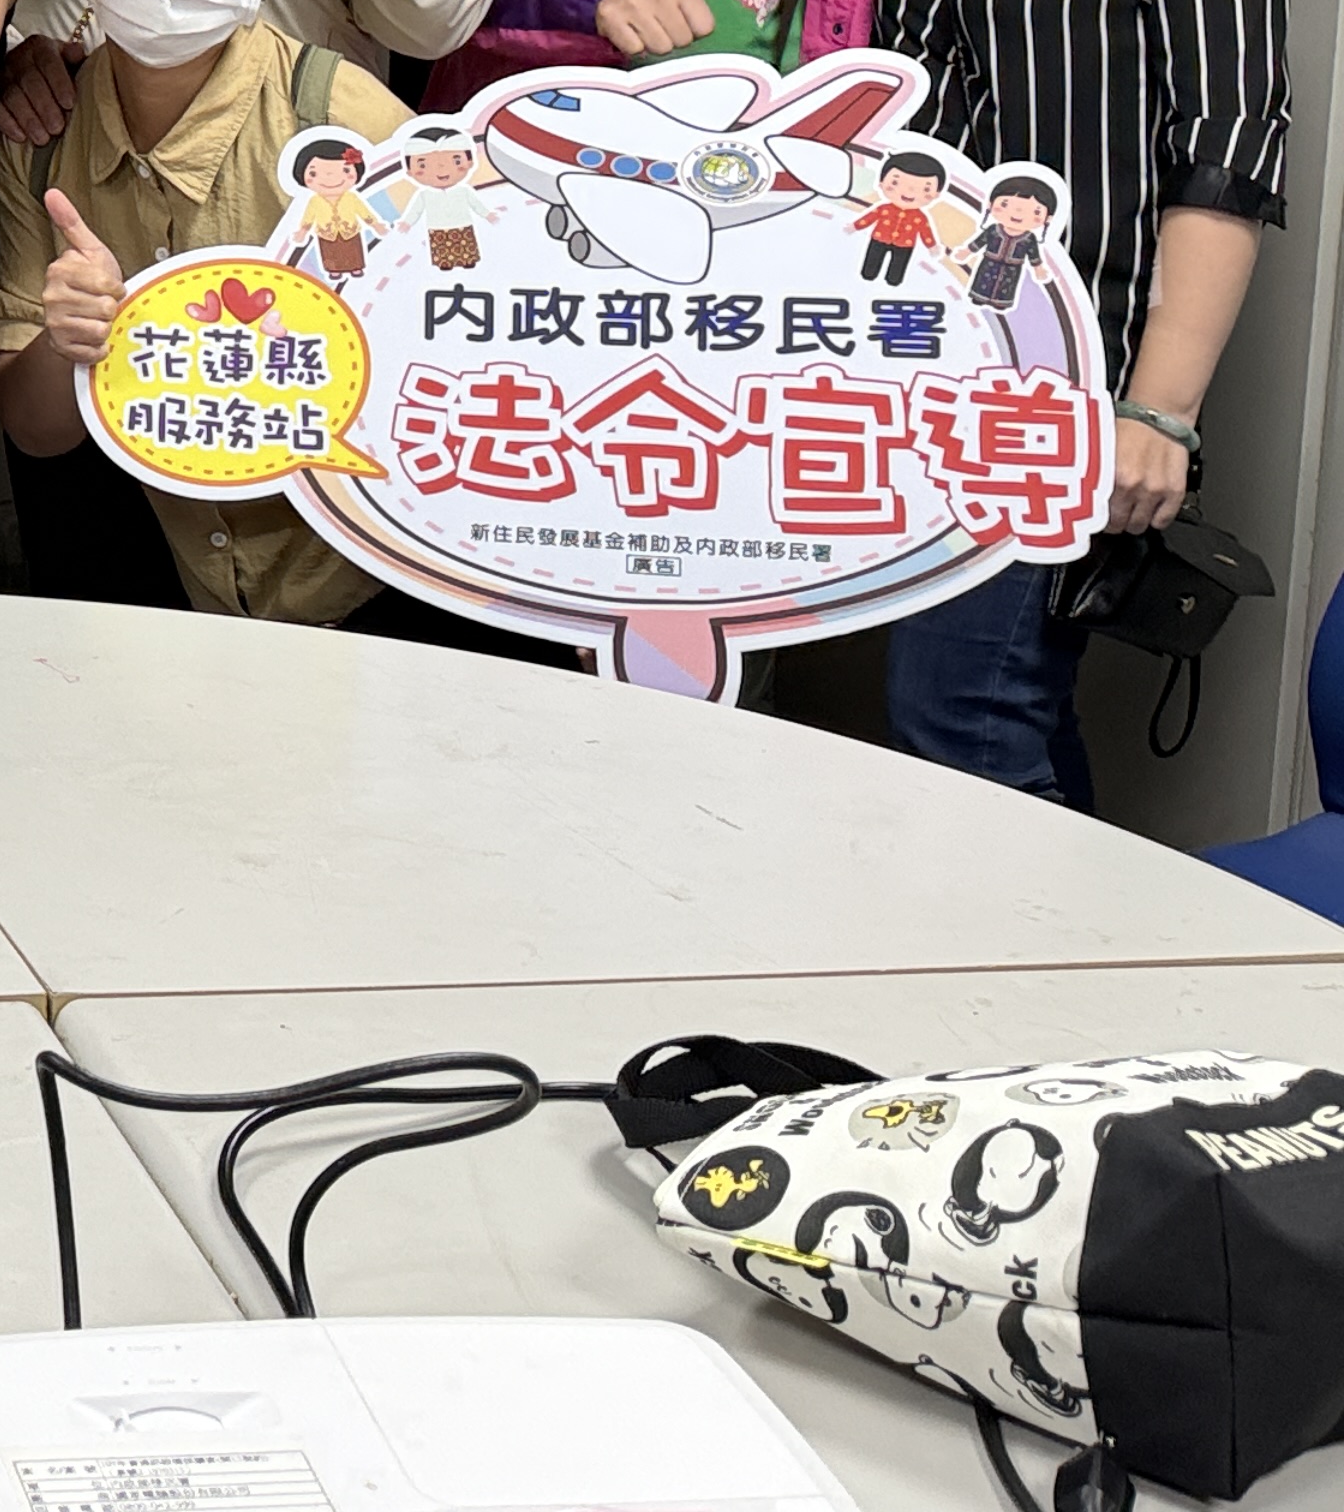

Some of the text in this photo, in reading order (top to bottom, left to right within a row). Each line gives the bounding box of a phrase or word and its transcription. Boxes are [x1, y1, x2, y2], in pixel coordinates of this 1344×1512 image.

[132, 326, 327, 385] 花蓮縣
[127, 396, 325, 451] 服務站
[395, 357, 1100, 545] 法令宣導
[1185, 1105, 1344, 1171] PEANUTS
